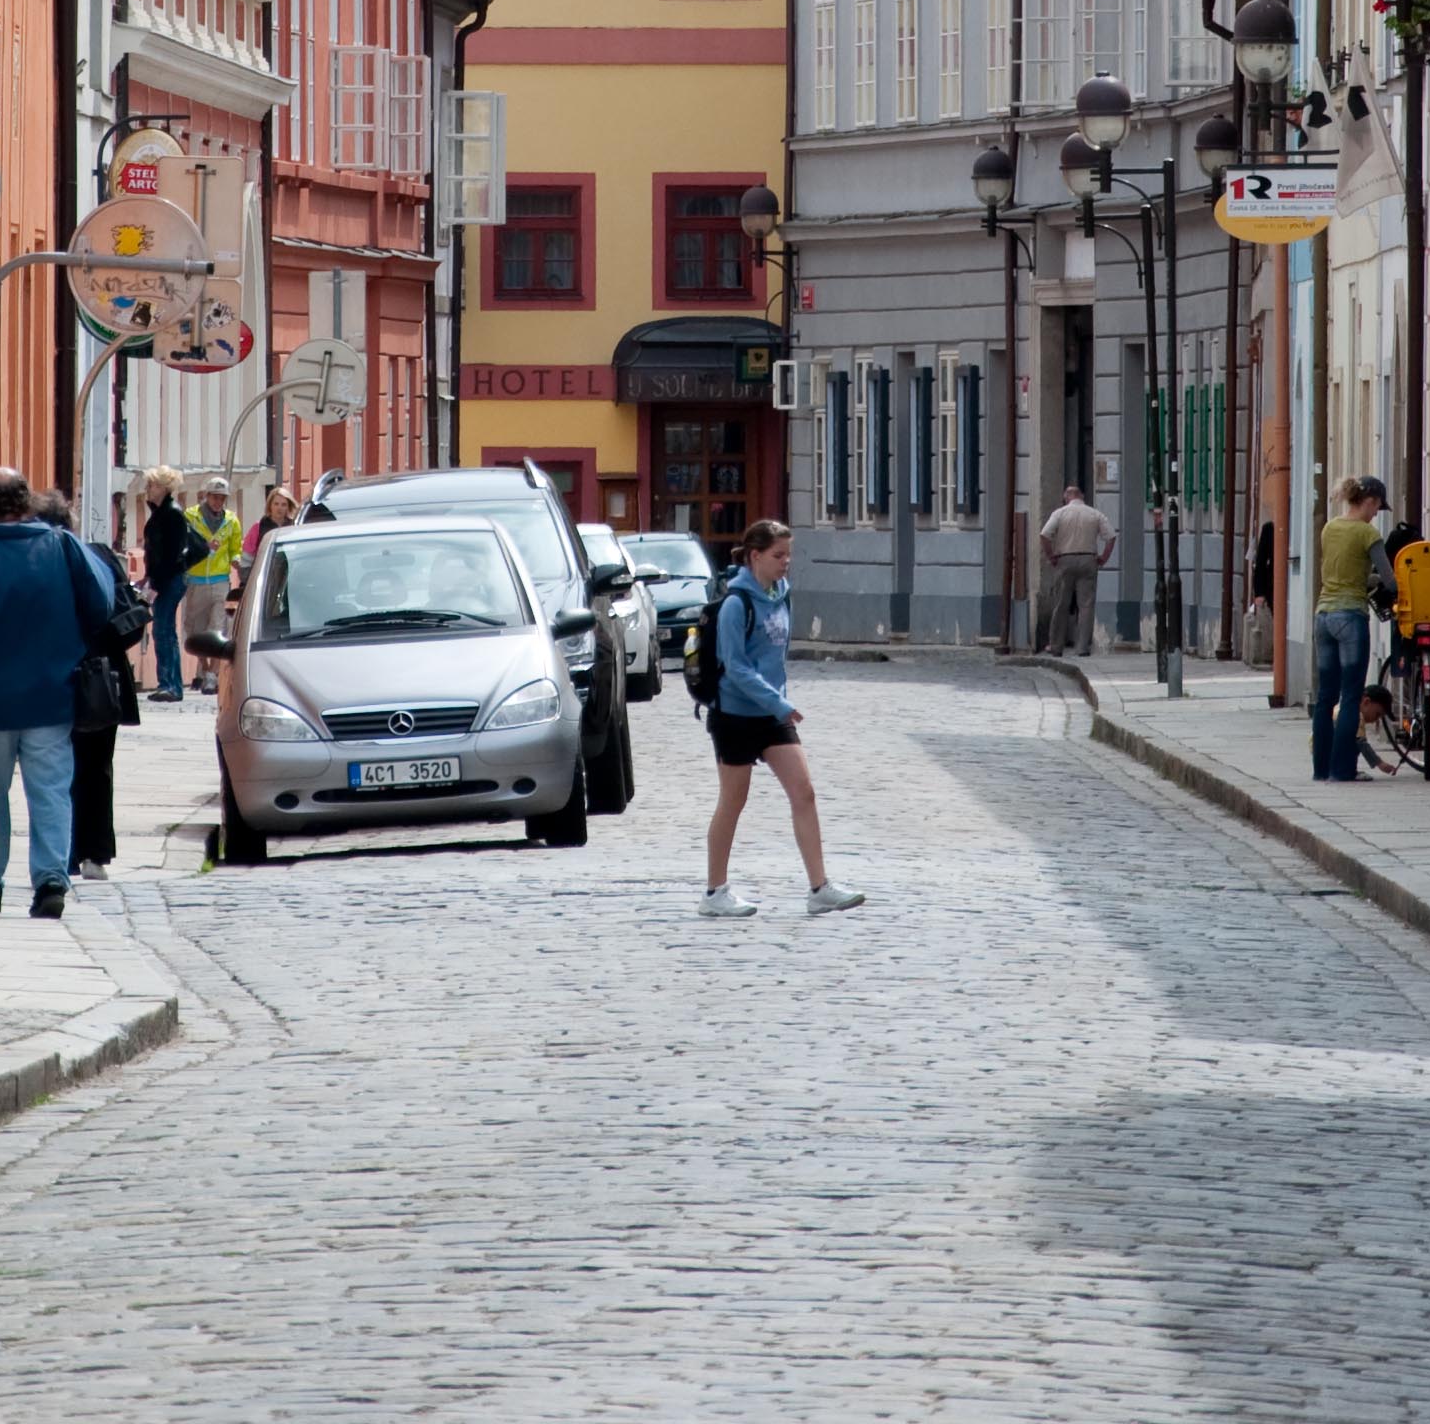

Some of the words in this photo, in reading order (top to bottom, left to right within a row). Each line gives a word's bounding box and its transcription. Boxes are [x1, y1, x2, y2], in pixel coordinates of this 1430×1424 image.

[474, 369, 602, 396] HOTEL
[365, 765, 395, 782] 4C1
[409, 761, 451, 780] 3520
